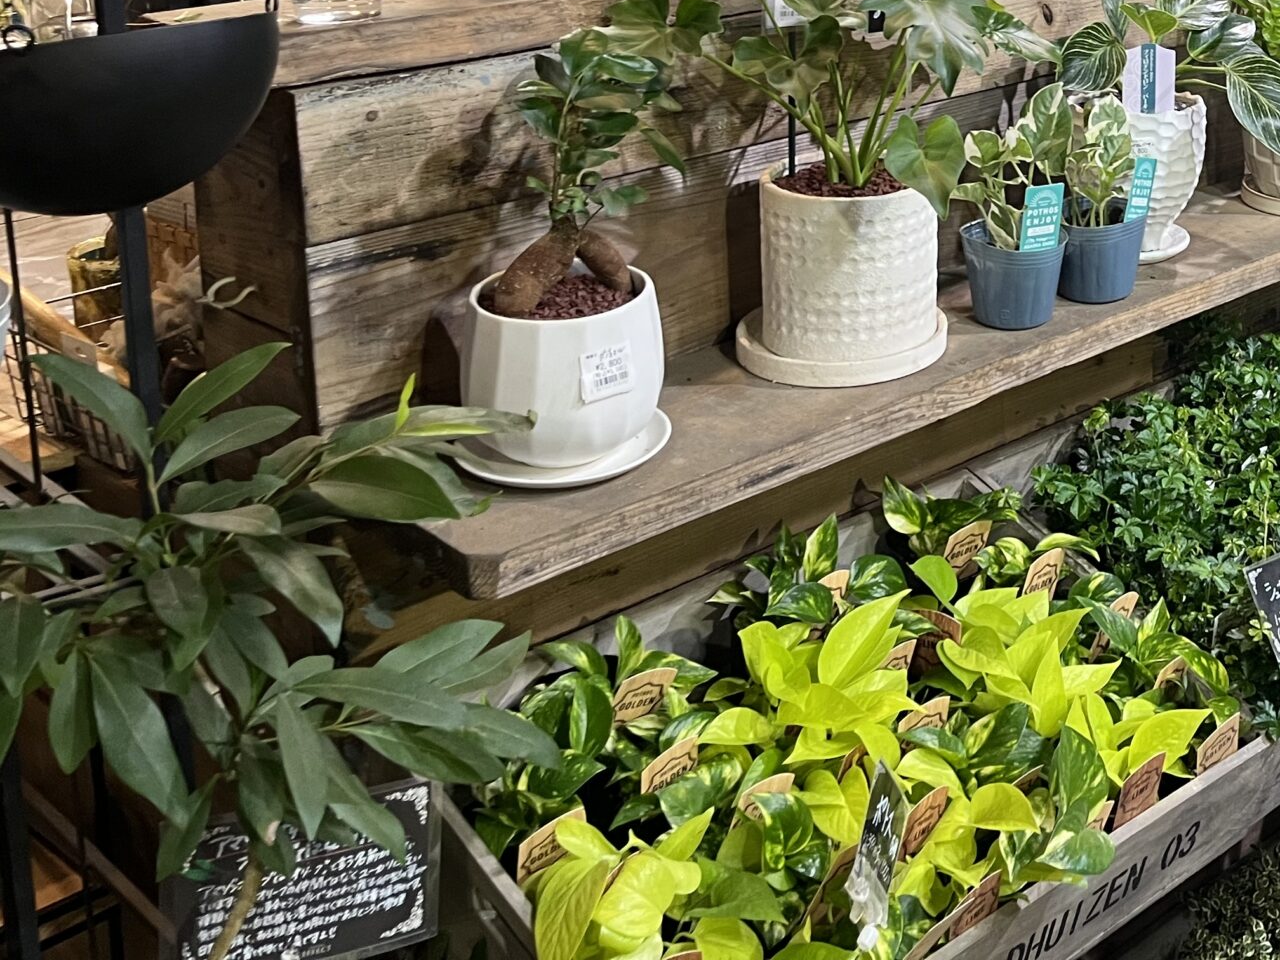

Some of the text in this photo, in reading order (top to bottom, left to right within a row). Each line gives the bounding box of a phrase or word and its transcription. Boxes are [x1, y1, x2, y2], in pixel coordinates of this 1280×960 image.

[1027, 206, 1059, 217] POTHOS
[1026, 215, 1058, 227] ENJOY
[618, 696, 658, 711] GOLDEN
[1160, 820, 1201, 871] 03
